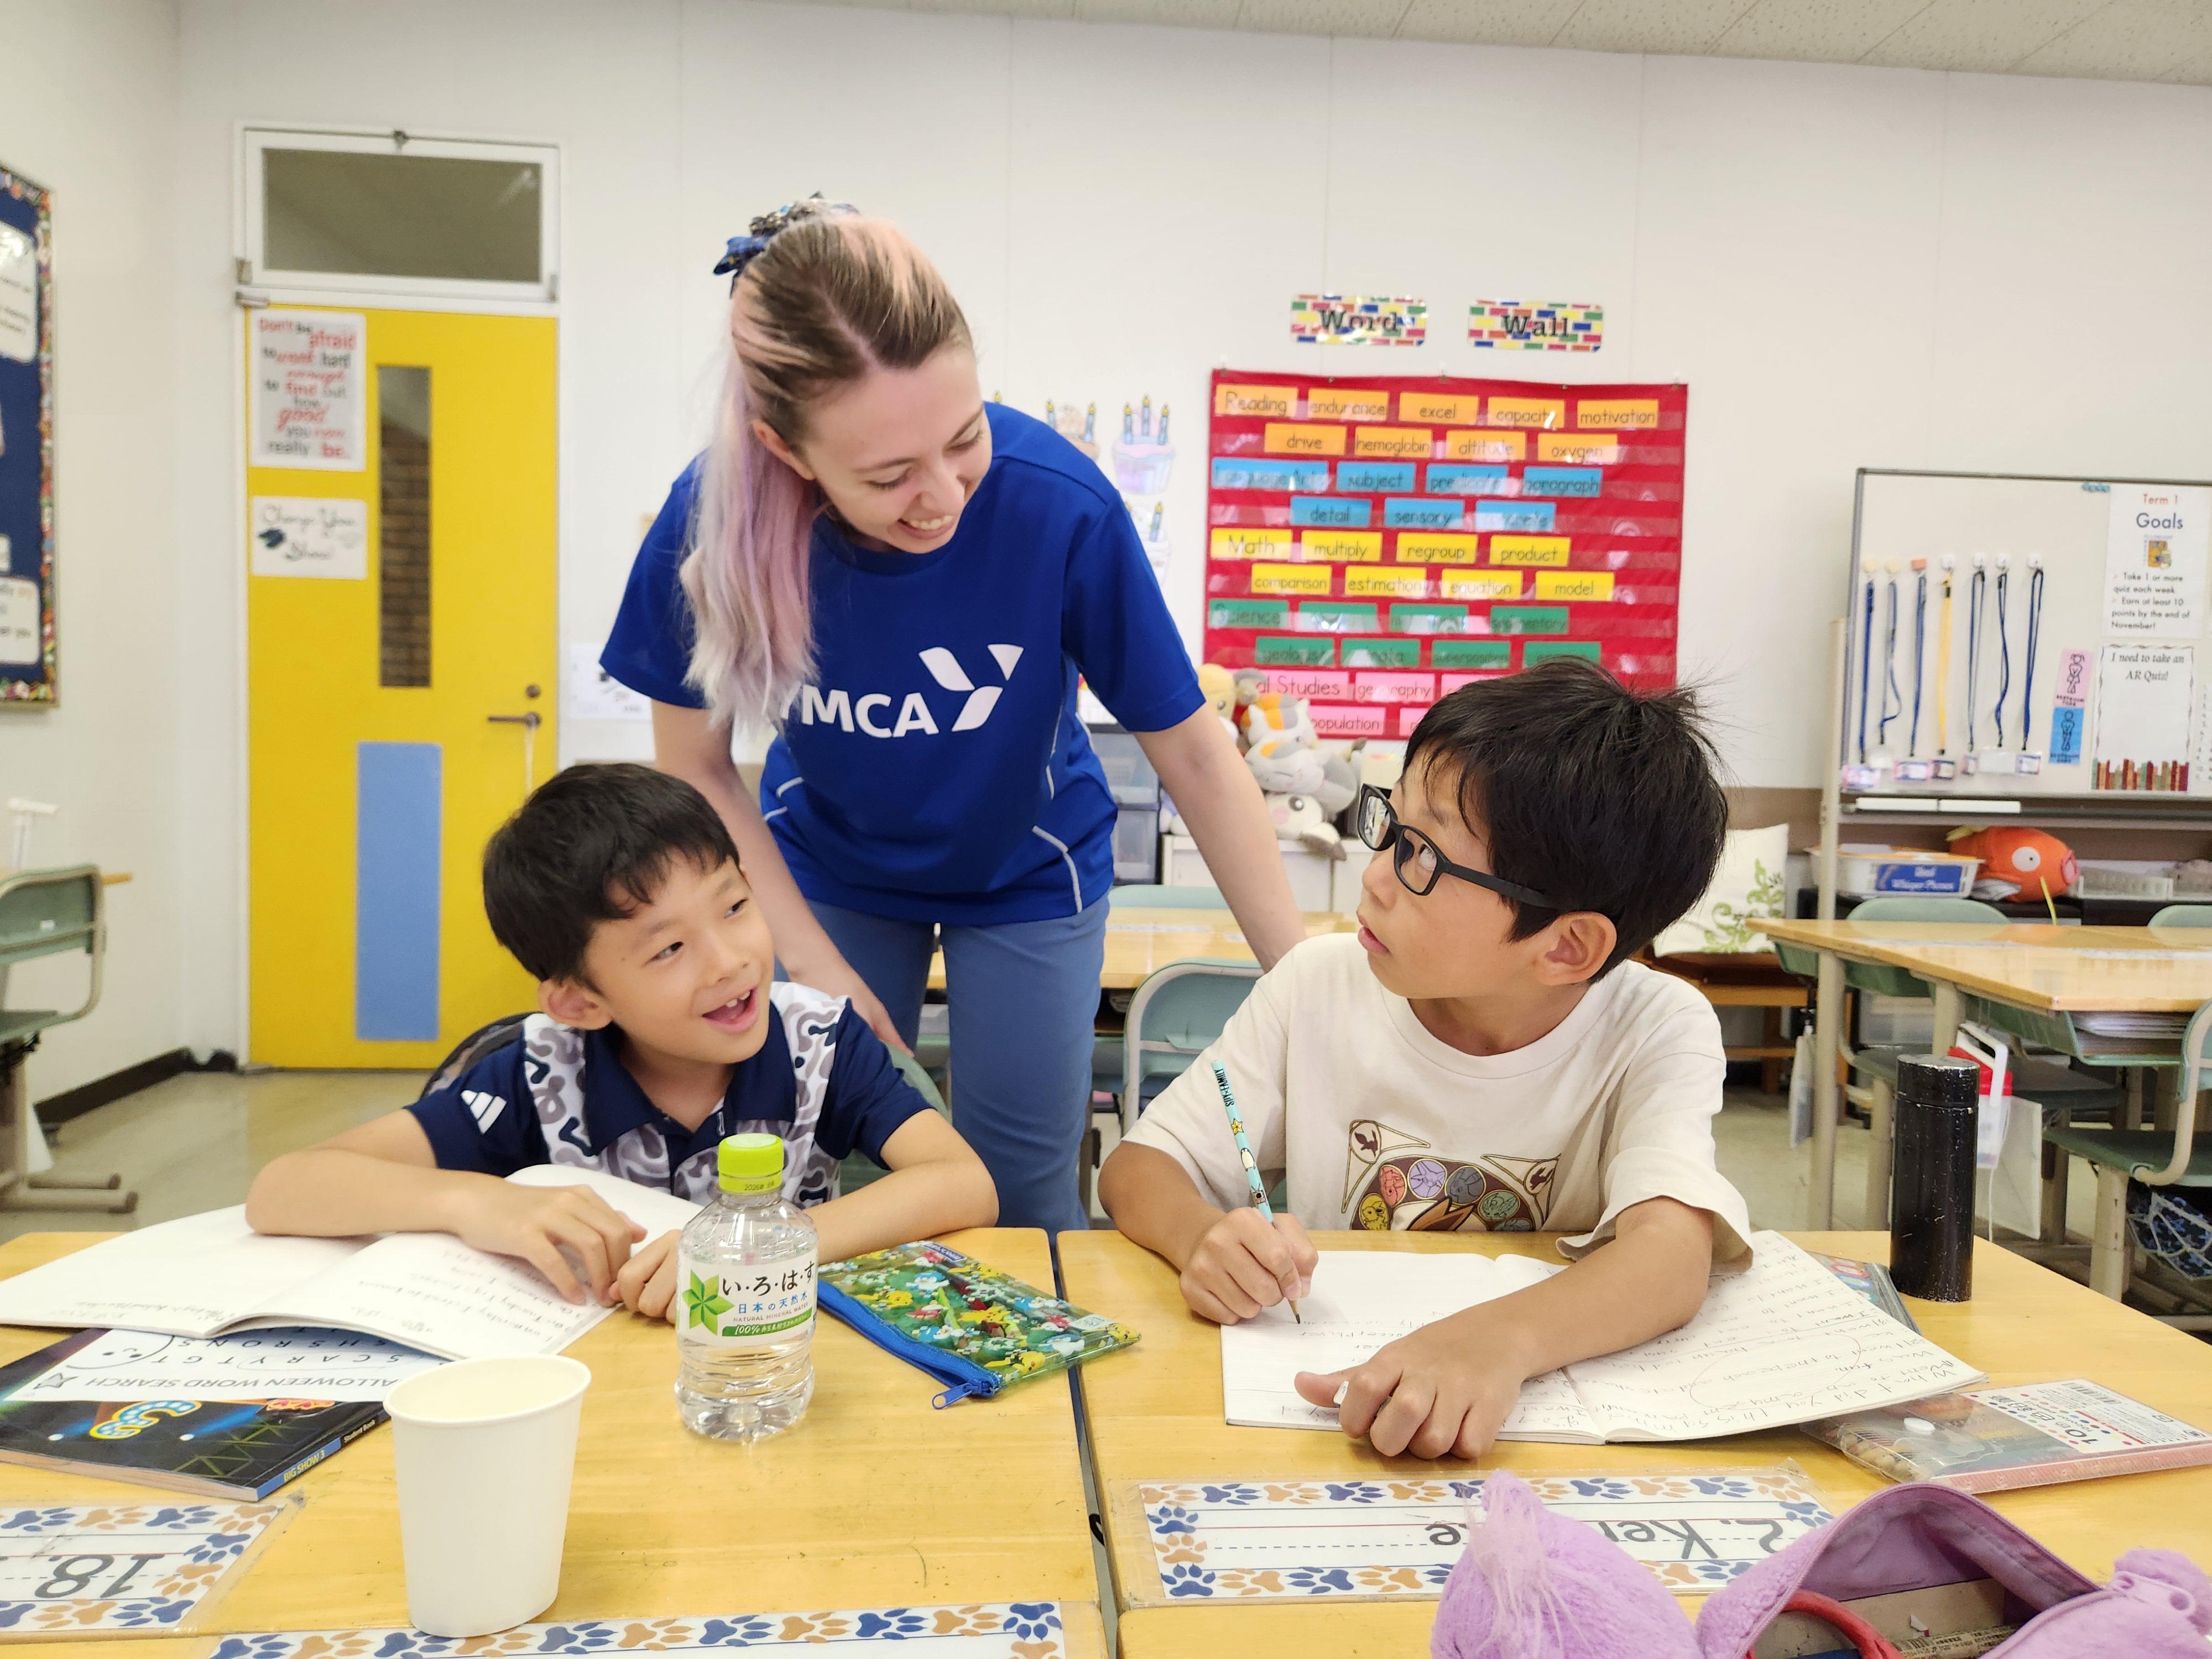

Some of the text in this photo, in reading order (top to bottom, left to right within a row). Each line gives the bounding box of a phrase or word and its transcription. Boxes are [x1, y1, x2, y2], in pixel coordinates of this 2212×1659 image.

[1319, 310, 1570, 338] Word Wall
[1225, 392, 1655, 427] Reading endurance excel capacit motivation
[1287, 435, 1603, 461] drive hemoglobin altitude oxygen
[1348, 472, 1403, 488] subject
[1526, 477, 1599, 493] paragraph
[2143, 493, 2168, 504] Term
[1310, 507, 1452, 528] detail sensory
[2136, 512, 2183, 529] Goals
[1228, 535, 1557, 562] Math multiply regroup product
[1254, 575, 1593, 595] comparison estimation equation model
[2124, 571, 2141, 581] Take
[2122, 597, 2139, 605] Earn
[2153, 597, 2171, 606] least
[2138, 609, 2147, 618] by
[2182, 610, 2190, 618] of
[2111, 653, 2116, 662] I
[2119, 653, 2138, 662] need
[2141, 654, 2150, 662] to
[2153, 653, 2171, 663] take
[2125, 670, 2141, 681] AR
[1278, 677, 1340, 695] Studies
[1313, 714, 1379, 733] population
[739, 1291, 807, 1314] 日本の天然水
[766, 1309, 792, 1319] MINERAL
[794, 1302, 808, 1312] WATER
[735, 1324, 760, 1335] 100%
[85, 1378, 400, 1387] ALLOWEEN WORD SEARCH
[284, 1449, 326, 1483] BIG SHOW 3
